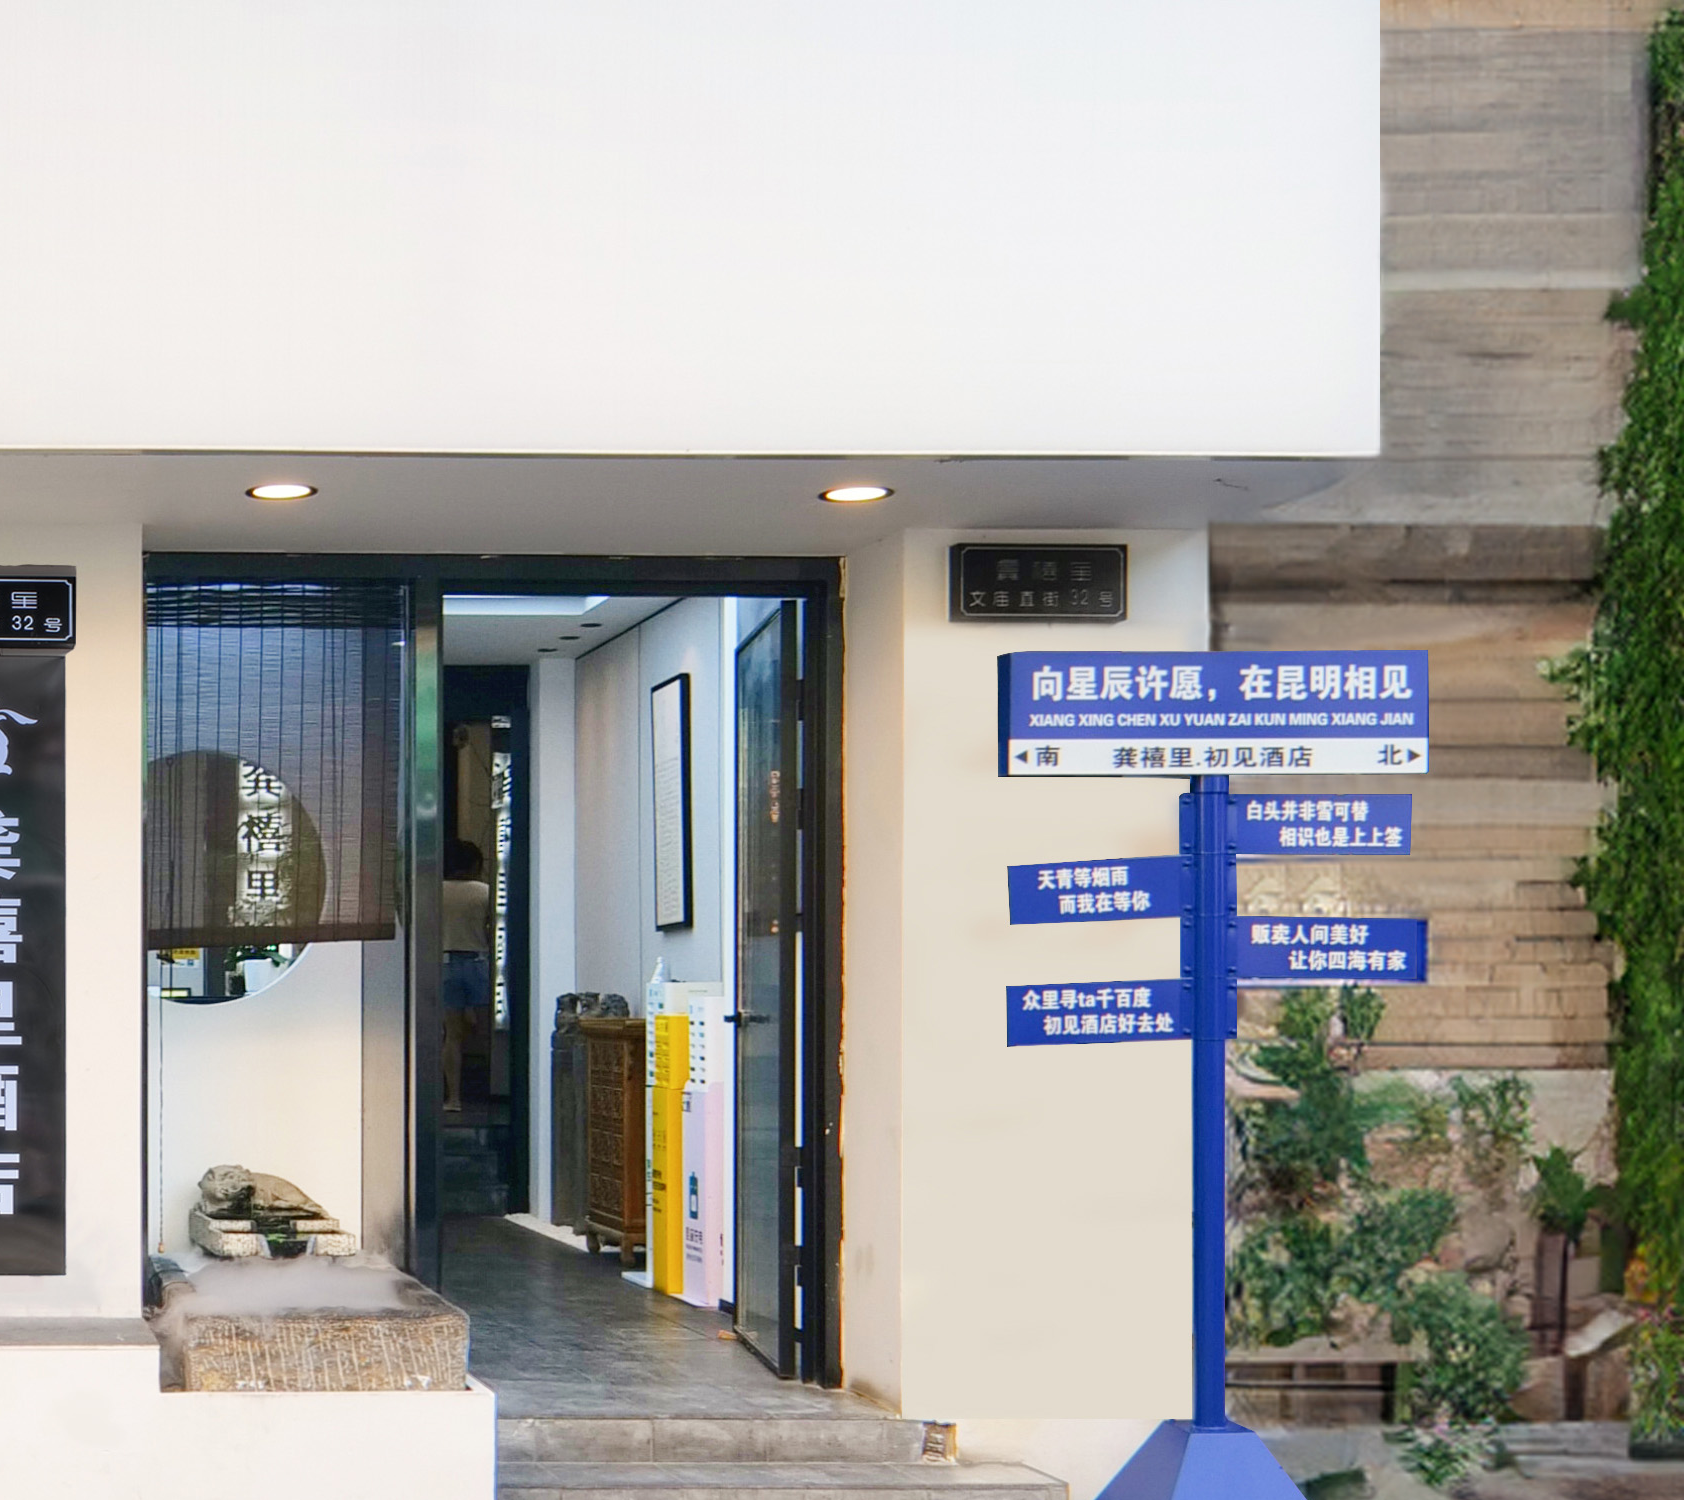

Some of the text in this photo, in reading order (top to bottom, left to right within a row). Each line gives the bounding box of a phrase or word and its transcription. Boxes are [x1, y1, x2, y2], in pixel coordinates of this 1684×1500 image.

[1028, 712, 1414, 728] XIANG XING CHEN XU YUAN ZAI KUN MING XIANG JIAN
[1036, 745, 1060, 767] 南
[1377, 744, 1402, 766] 北
[1246, 800, 1369, 822] 白头并非雪可替
[1279, 826, 1403, 848] 相识也是上上签
[1037, 865, 1129, 891] 天青等烟雨
[1058, 891, 1151, 915] 而我在等你
[1250, 923, 1370, 946] 贩卖人间美好
[1287, 949, 1408, 972] 让你四海有家
[1022, 987, 1152, 1011] 众里寻ta千百度
[1043, 1012, 1174, 1036] 初见酒店好去处
